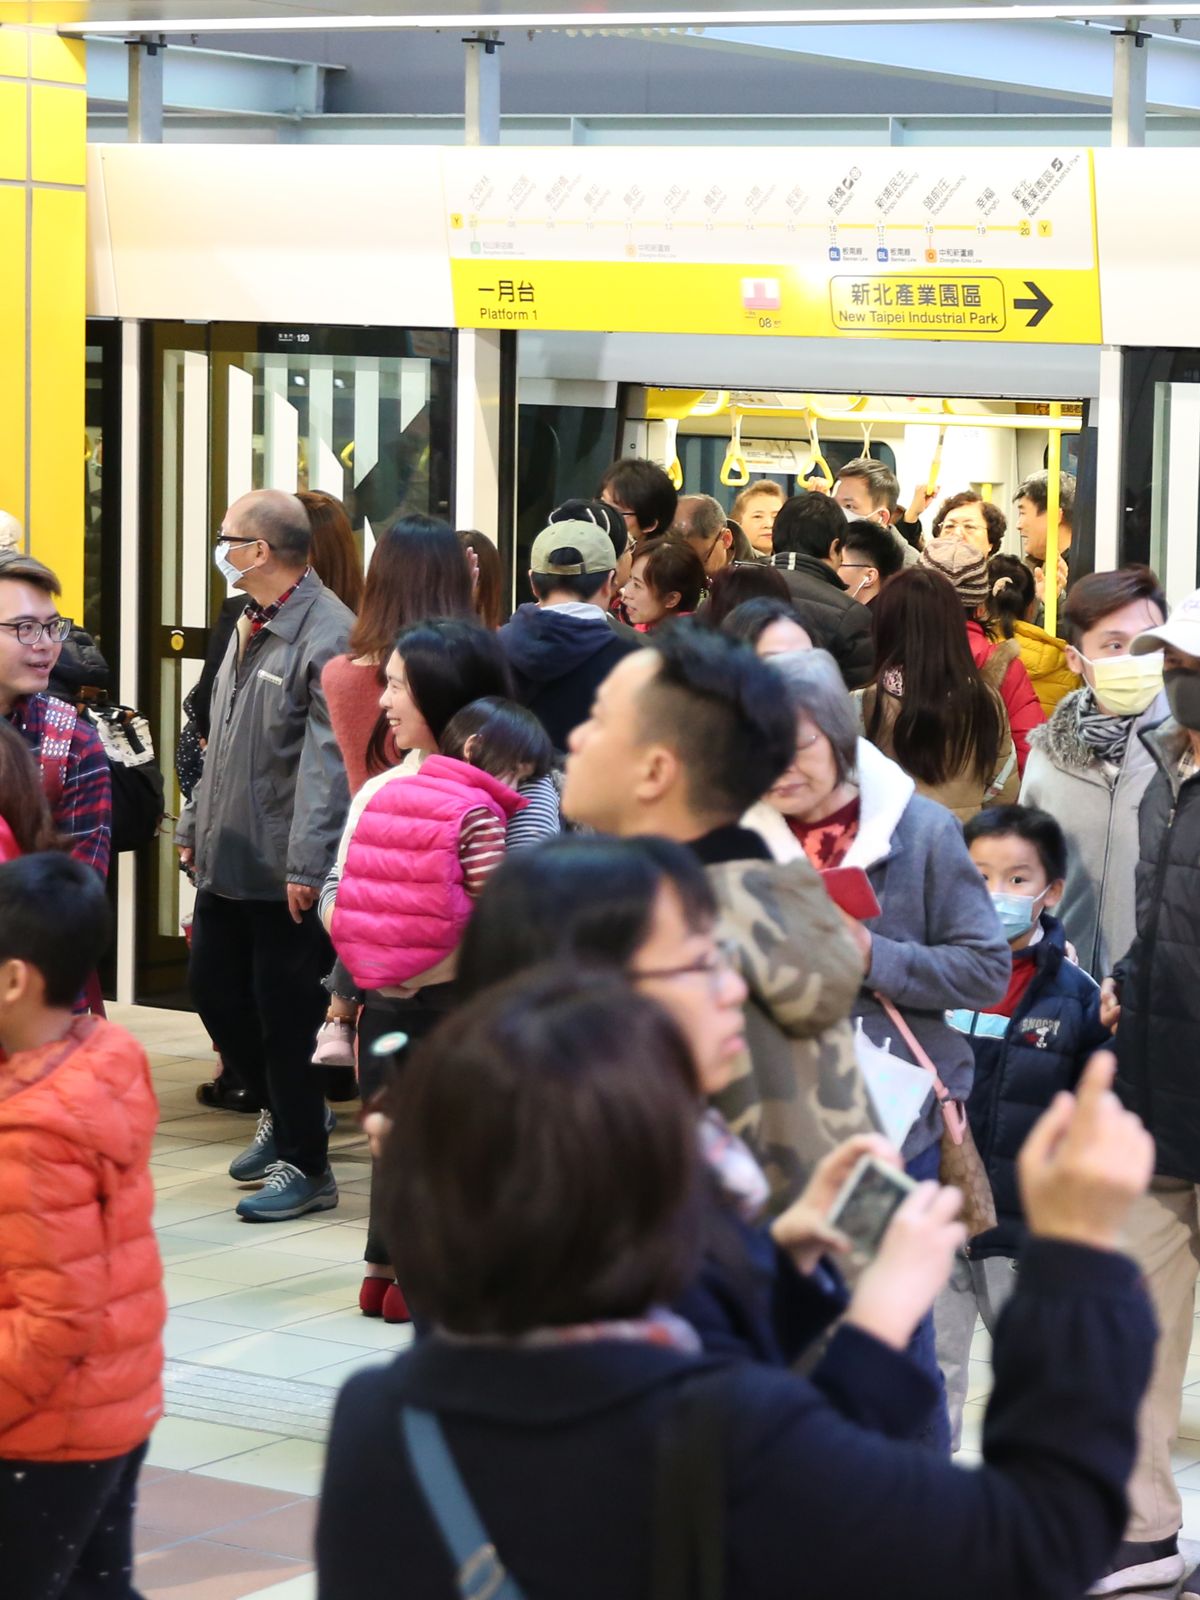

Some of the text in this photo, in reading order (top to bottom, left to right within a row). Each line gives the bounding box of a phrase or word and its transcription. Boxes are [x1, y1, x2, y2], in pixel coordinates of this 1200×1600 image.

[1020, 227, 1030, 236] 20
[1041, 224, 1048, 233] Y
[478, 280, 535, 303] 一月台
[851, 283, 981, 308] 新北產業園區
[480, 307, 538, 321] Platform 1
[839, 310, 998, 325] New Taipei Industrial Park
